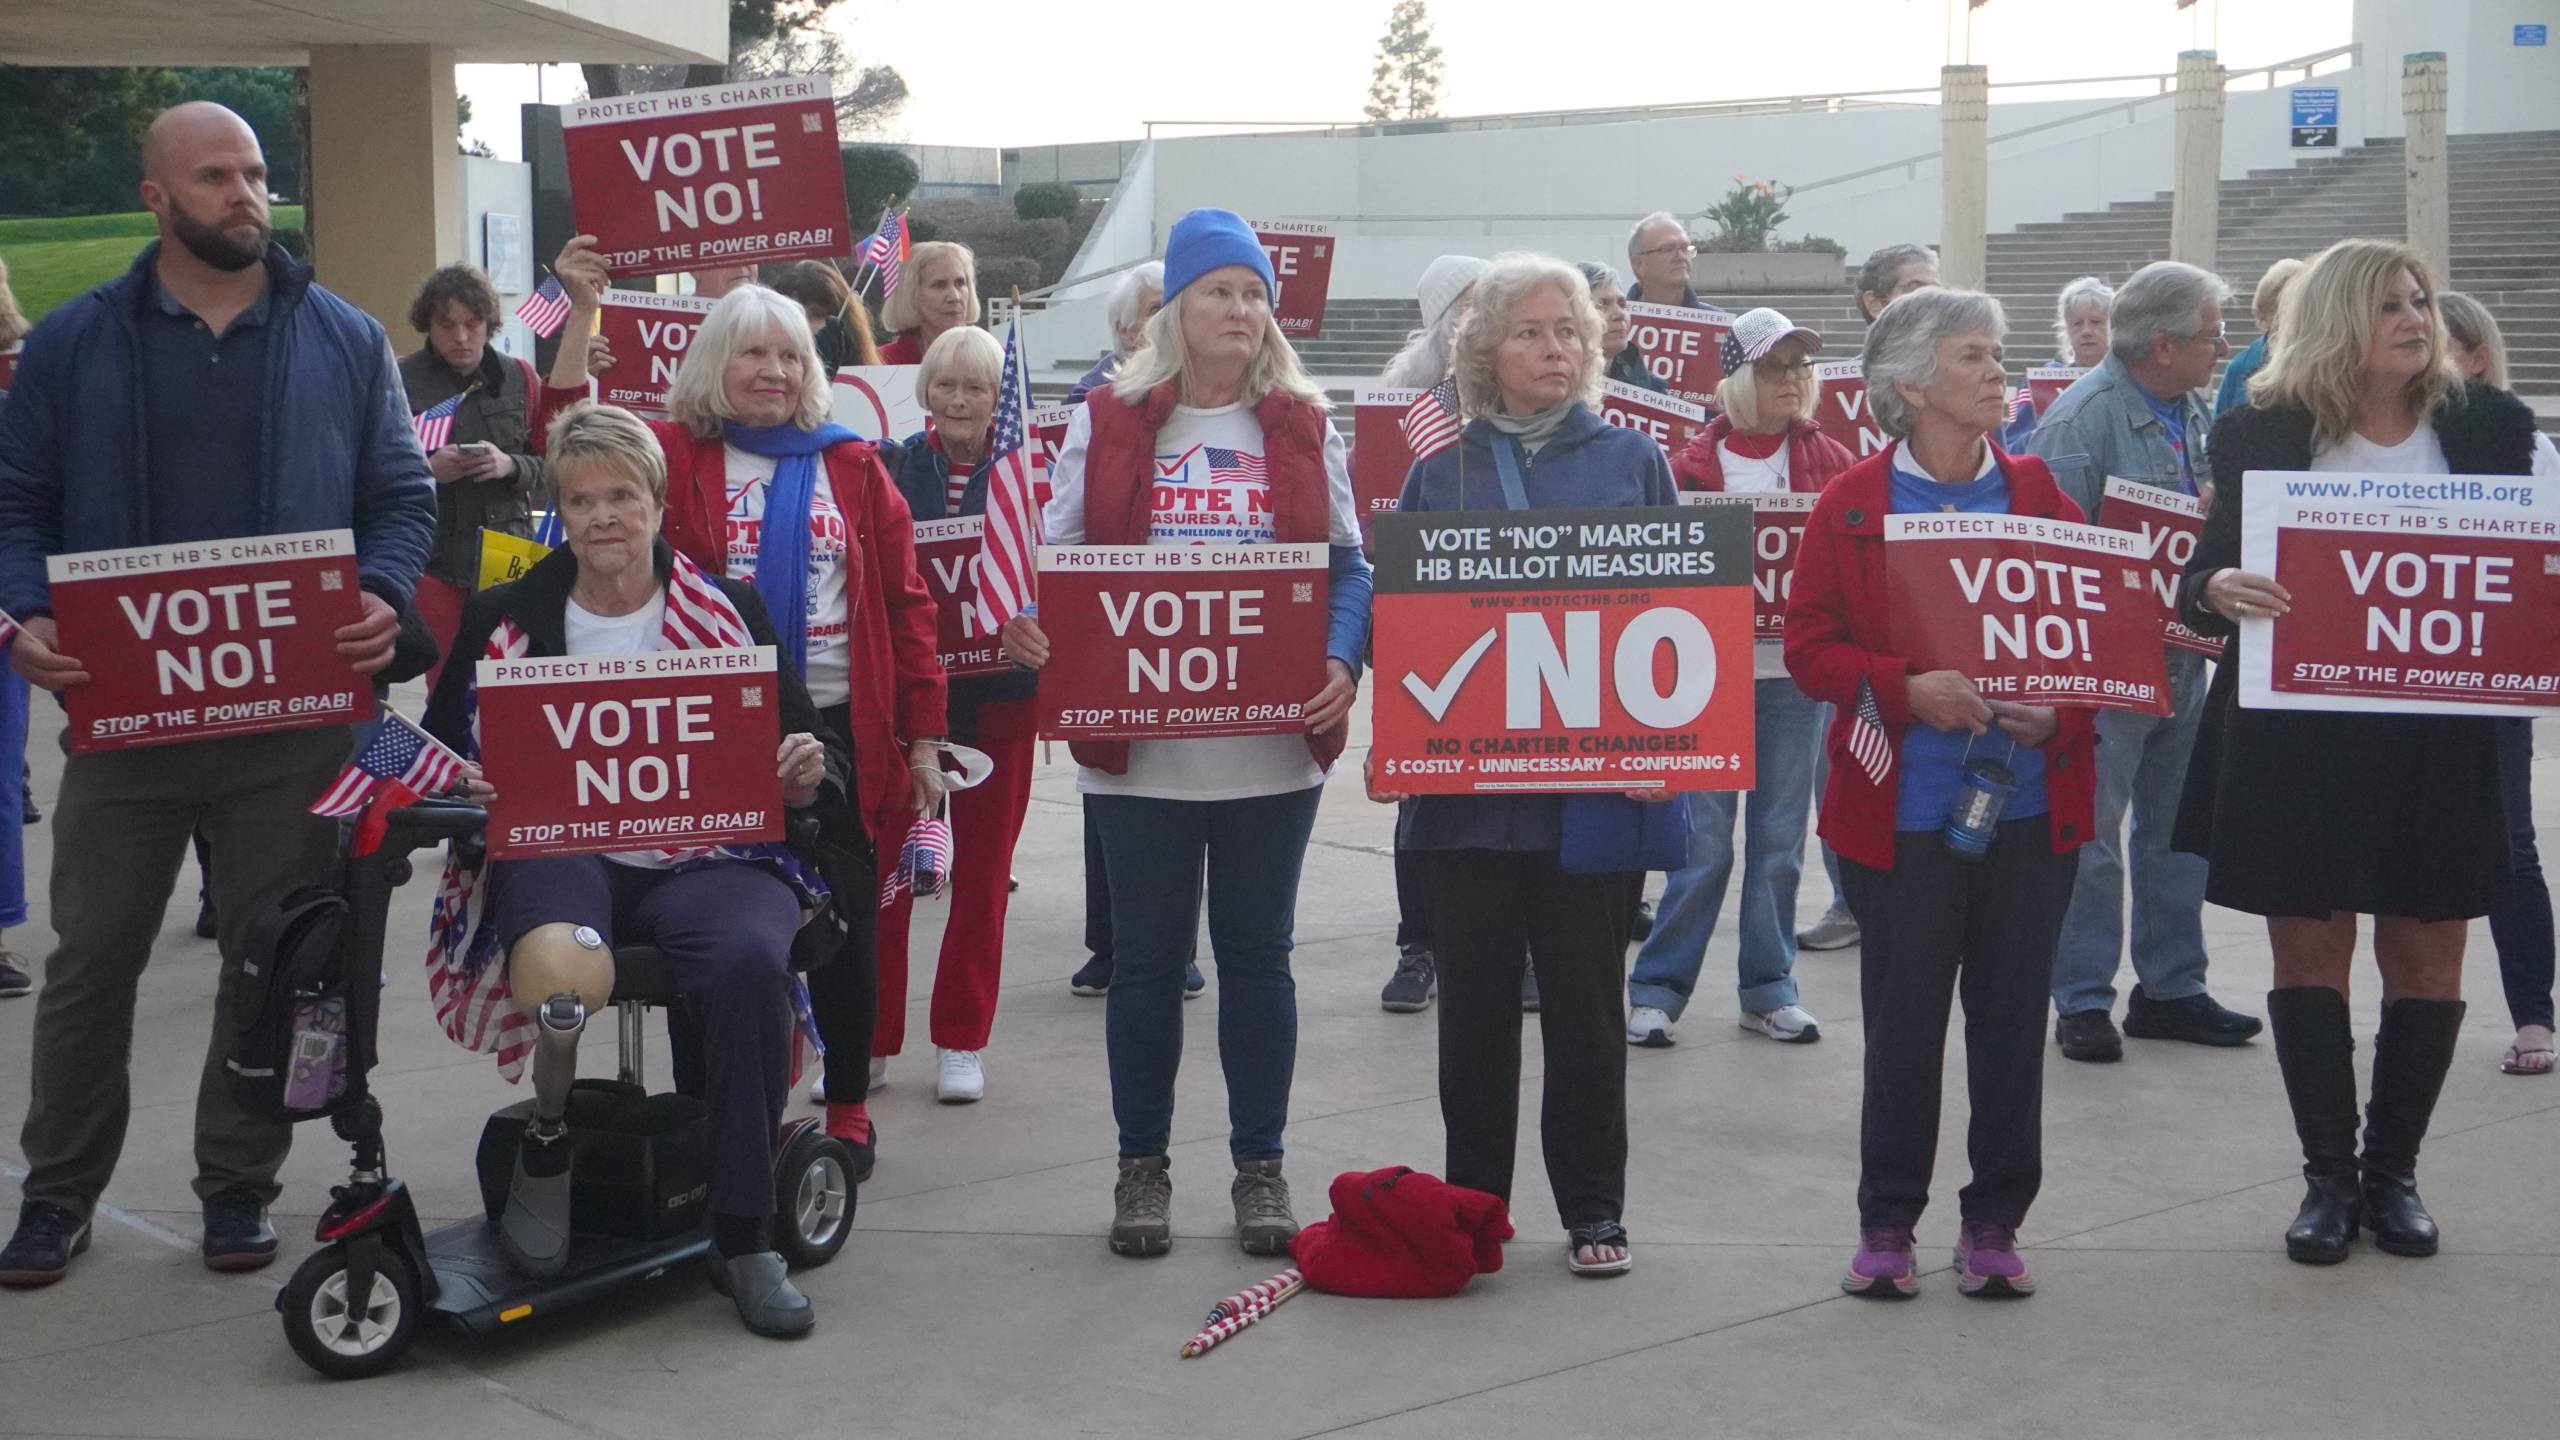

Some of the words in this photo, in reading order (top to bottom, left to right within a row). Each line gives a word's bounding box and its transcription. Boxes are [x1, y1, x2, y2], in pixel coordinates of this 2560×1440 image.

[577, 100, 658, 120] PROTECT
[668, 94, 712, 110] HB'S
[721, 82, 815, 104] CHARTER!
[620, 122, 781, 182] VOTE
[655, 178, 763, 233] NO!
[1249, 220, 1270, 230] B'S
[1274, 222, 1328, 233] CHARTER!
[604, 248, 650, 267] STOP
[650, 244, 693, 261] THE
[700, 234, 769, 256] POWER
[774, 228, 833, 247] GRAB!
[1261, 245, 1300, 275] TE
[612, 293, 667, 307] PROTECT
[672, 300, 701, 310] HB'S
[1648, 306, 1672, 316] HB'S
[1676, 310, 1728, 322] CHARTER!
[637, 319, 702, 352] VO
[1280, 318, 1313, 329] GRAB!
[1644, 355, 1685, 383] O!
[1823, 365, 1858, 376] OTEC
[609, 388, 642, 400] STOP
[1368, 392, 1423, 402] PROTEC
[1613, 385, 1639, 399] HB'S
[1643, 394, 1696, 413] CHARTER!
[1602, 404, 1671, 452] OTE
[1151, 486, 1232, 512] OTE
[1247, 488, 1273, 513] N
[1370, 498, 1399, 509] STO
[1769, 497, 1805, 509] HB'S
[2117, 484, 2180, 509] PROTECT
[2286, 479, 2533, 506] www.ProtectHB.org
[915, 523, 965, 538] OTECT
[1151, 513, 1220, 525] ASURES
[1225, 514, 1243, 528] A,
[1249, 514, 1265, 528] B,
[1178, 528, 1233, 537] MILLIONS
[1235, 529, 1251, 537] OF
[2297, 510, 2391, 527] PROTECT
[2400, 514, 2449, 529] HB'S
[2458, 518, 2559, 535] CHARTER
[1419, 527, 1491, 552] VOTE
[1499, 526, 1573, 550] “NO”
[1579, 522, 1681, 549] MARCH
[1687, 521, 1706, 545] 5
[1903, 520, 1995, 535] PROTECT
[2003, 521, 2046, 537] HB'S
[2052, 527, 2135, 552] CHARTER!
[2140, 521, 2199, 567] VO
[68, 554, 163, 576] PROTECT
[173, 547, 223, 565] HB'S
[231, 537, 336, 559] CHARTER!
[1055, 553, 1147, 567] PROTECT
[1155, 552, 1203, 566] HB'S
[1211, 551, 1312, 566] CHARTER!
[1416, 558, 1452, 582] HB
[1459, 554, 1561, 581] BALLOT
[1567, 551, 1715, 578] MEASURES
[1949, 557, 2107, 612] VOTE
[2339, 550, 2514, 603] VOTE
[117, 580, 297, 641] VOTE
[1098, 589, 1265, 638] VOTE
[1470, 593, 1652, 609] WWW.PROTECTHB.ORG
[1982, 613, 2093, 662] NO!
[2366, 606, 2485, 657] NO!
[155, 638, 277, 696] NO!
[495, 663, 588, 681] PROTECT
[599, 659, 647, 675] HB'S
[656, 653, 759, 672] CHARTER!
[958, 649, 992, 665] THE
[1128, 646, 1239, 694] NO!
[1505, 606, 1717, 730] NO
[1974, 677, 2017, 693] THE
[2024, 674, 2099, 693] POWER
[2103, 680, 2156, 700] GRAB!
[2293, 663, 2350, 680] STOP
[2354, 666, 2397, 683] THE
[2404, 669, 2484, 688] POWER
[2491, 673, 2559, 692] GRAB!
[92, 714, 151, 736] STOP
[153, 709, 197, 729] THE
[204, 700, 282, 723] POWER
[288, 692, 355, 713] GRAB!
[542, 695, 715, 750] VOTE
[1060, 709, 1115, 726] STOP
[1118, 709, 1159, 725] THE
[1165, 705, 1239, 725] POWER
[1245, 703, 1307, 720] GRAB!
[1426, 738, 1461, 756] NO
[1468, 736, 1570, 755] CHARTER
[1578, 733, 1699, 754] CHANGES!
[1385, 759, 1396, 776] $
[1400, 759, 1464, 774] COSTLY
[1478, 757, 1606, 773] UNNECESSARY
[1620, 755, 1726, 772] CONFUSING
[1729, 754, 1741, 771] $
[574, 753, 691, 807] NO!
[508, 824, 565, 843] STOP
[568, 821, 611, 839] THE
[618, 814, 695, 835] POWER
[700, 810, 765, 830] GRAB!
